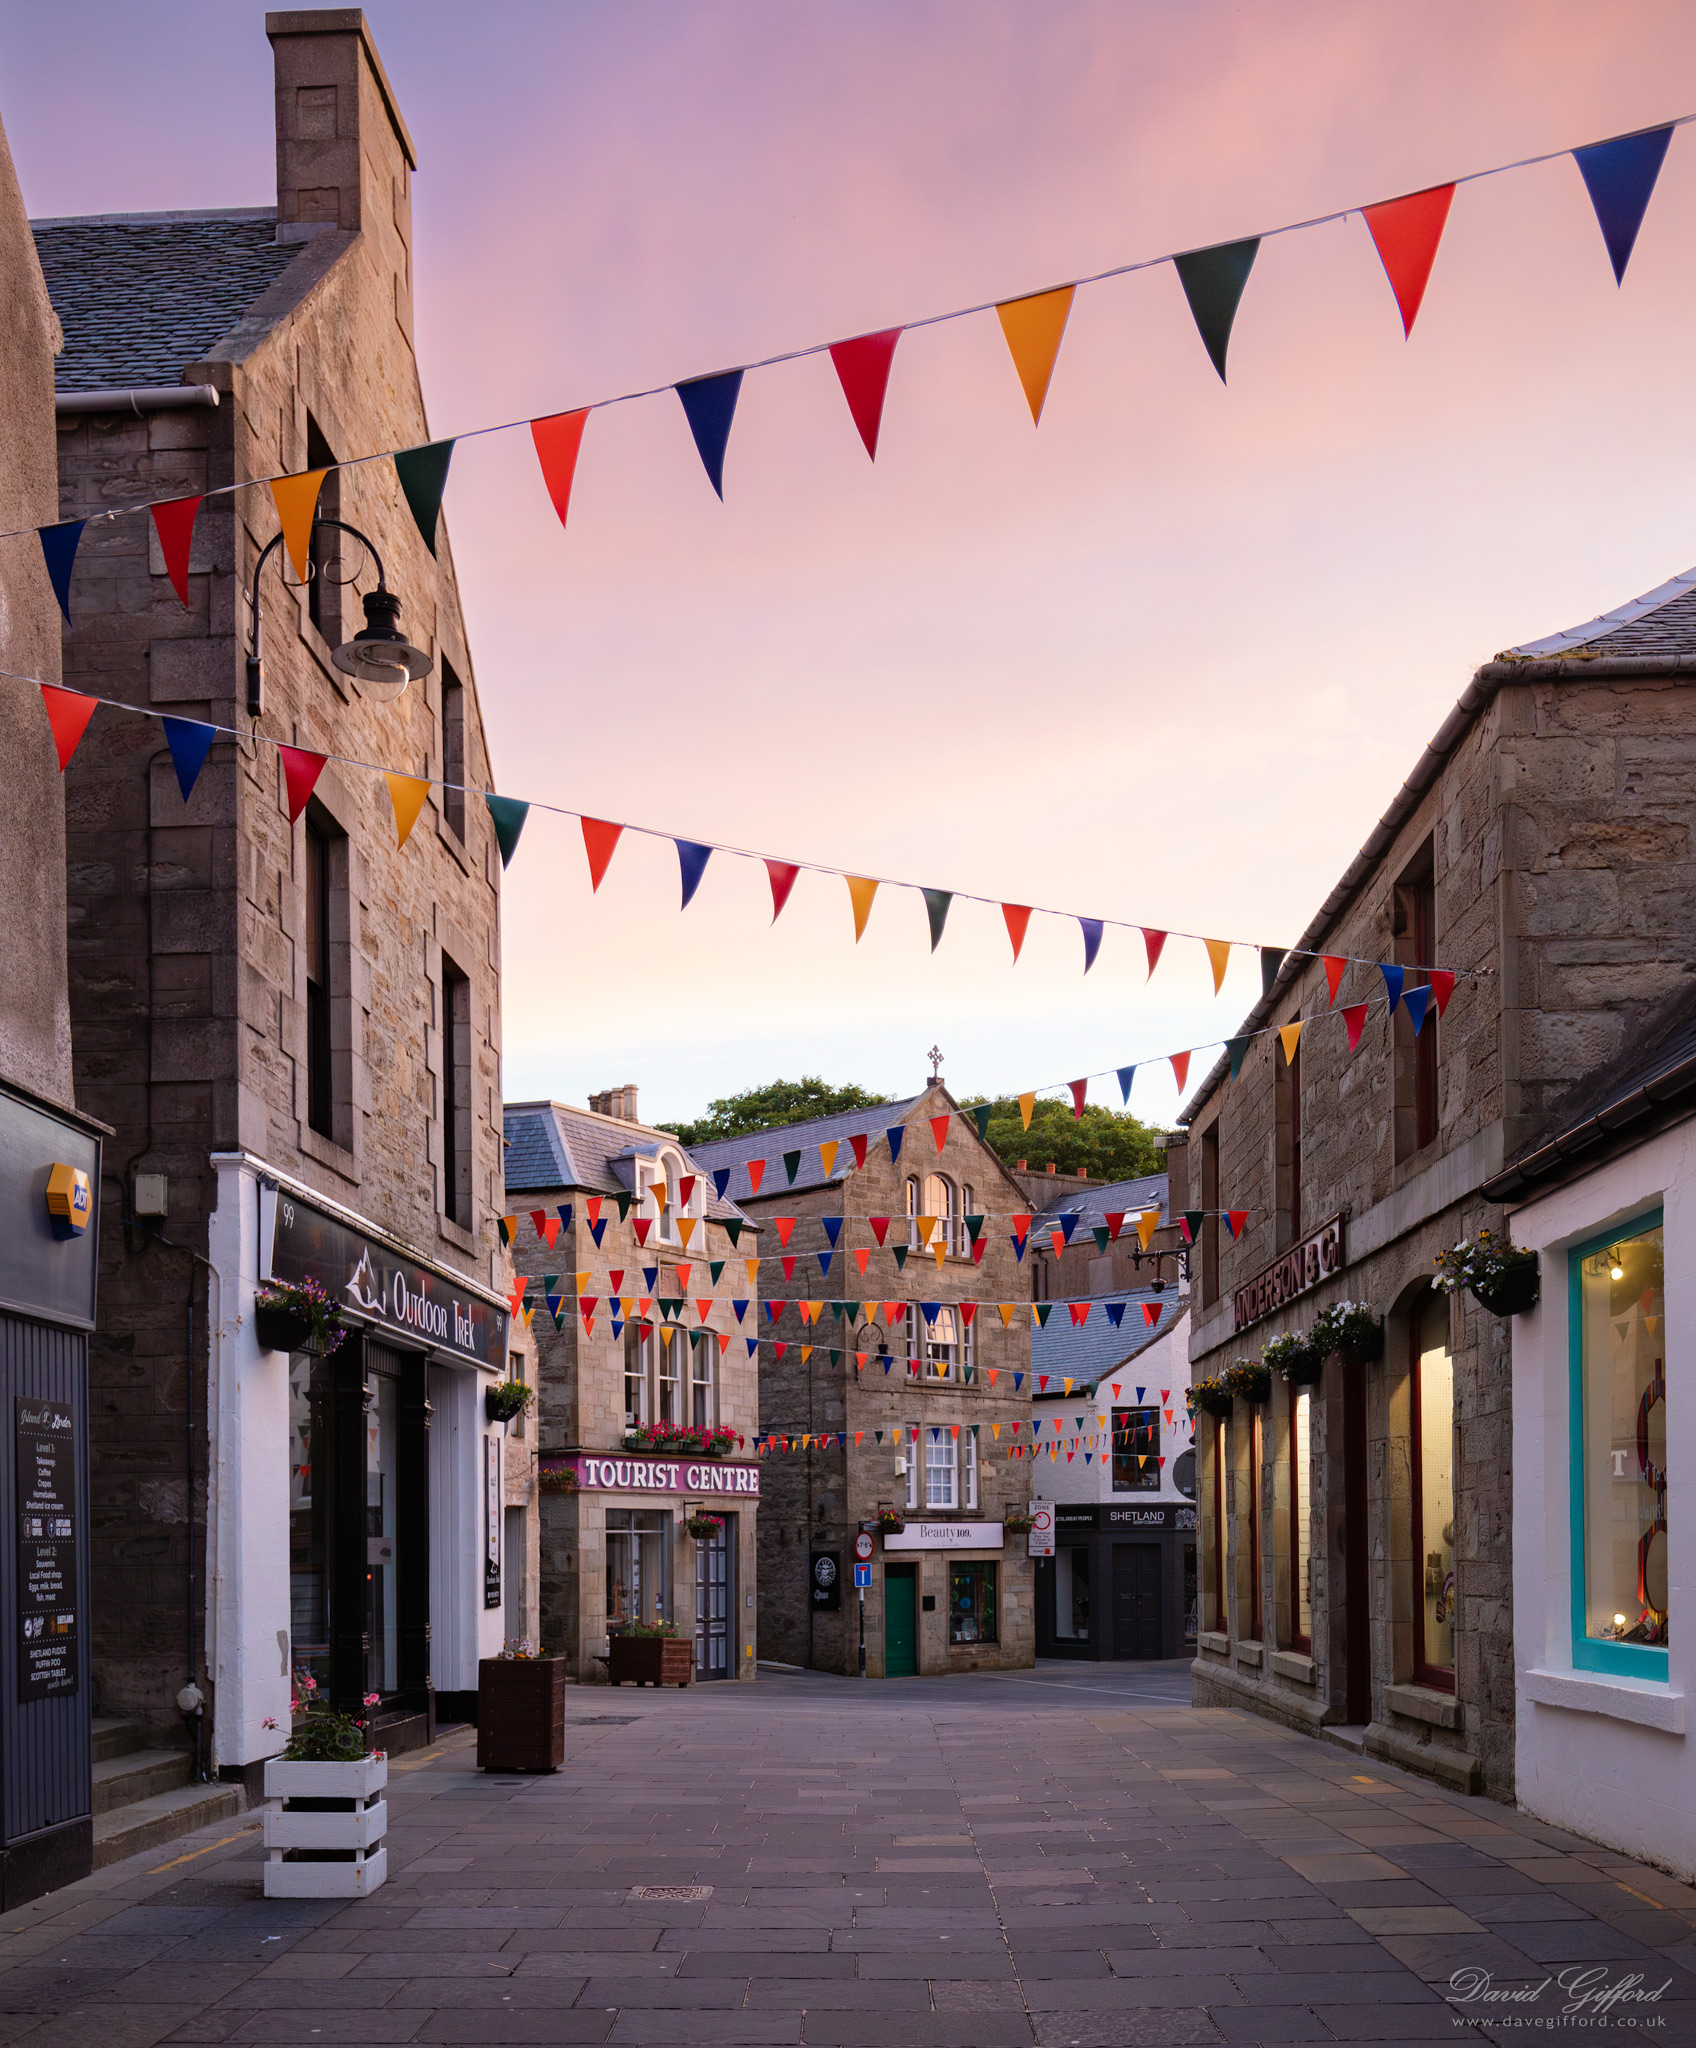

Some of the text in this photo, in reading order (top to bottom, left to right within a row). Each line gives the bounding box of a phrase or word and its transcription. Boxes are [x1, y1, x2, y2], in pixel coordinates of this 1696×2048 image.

[74, 1190, 87, 1208] ADT
[283, 1203, 295, 1229] 99
[1235, 1247, 1305, 1333] ANDERSON
[1305, 1243, 1320, 1283] &
[496, 1314, 503, 1333] 99
[21, 1408, 41, 1425] Island
[36, 1442, 51, 1453] Level
[38, 1468, 51, 1477] Coffee
[585, 1459, 759, 1492] TOURIST CENTRE
[38, 1479, 52, 1489] Crepes
[26, 1500, 44, 1510] Shetland
[51, 1503, 64, 1511] cream
[1110, 1511, 1165, 1521] SHETLAND
[920, 1525, 956, 1542] Beauty
[37, 1546, 51, 1556] Level
[36, 1560, 55, 1568] Souvenirs
[29, 1571, 40, 1580] Local
[40, 1570, 51, 1579] Food
[30, 1646, 66, 1658] SHETLAND FUDGE
[36, 1657, 61, 1669] PUFFIN POO
[31, 1668, 66, 1681] SCOTTISH TABLET
